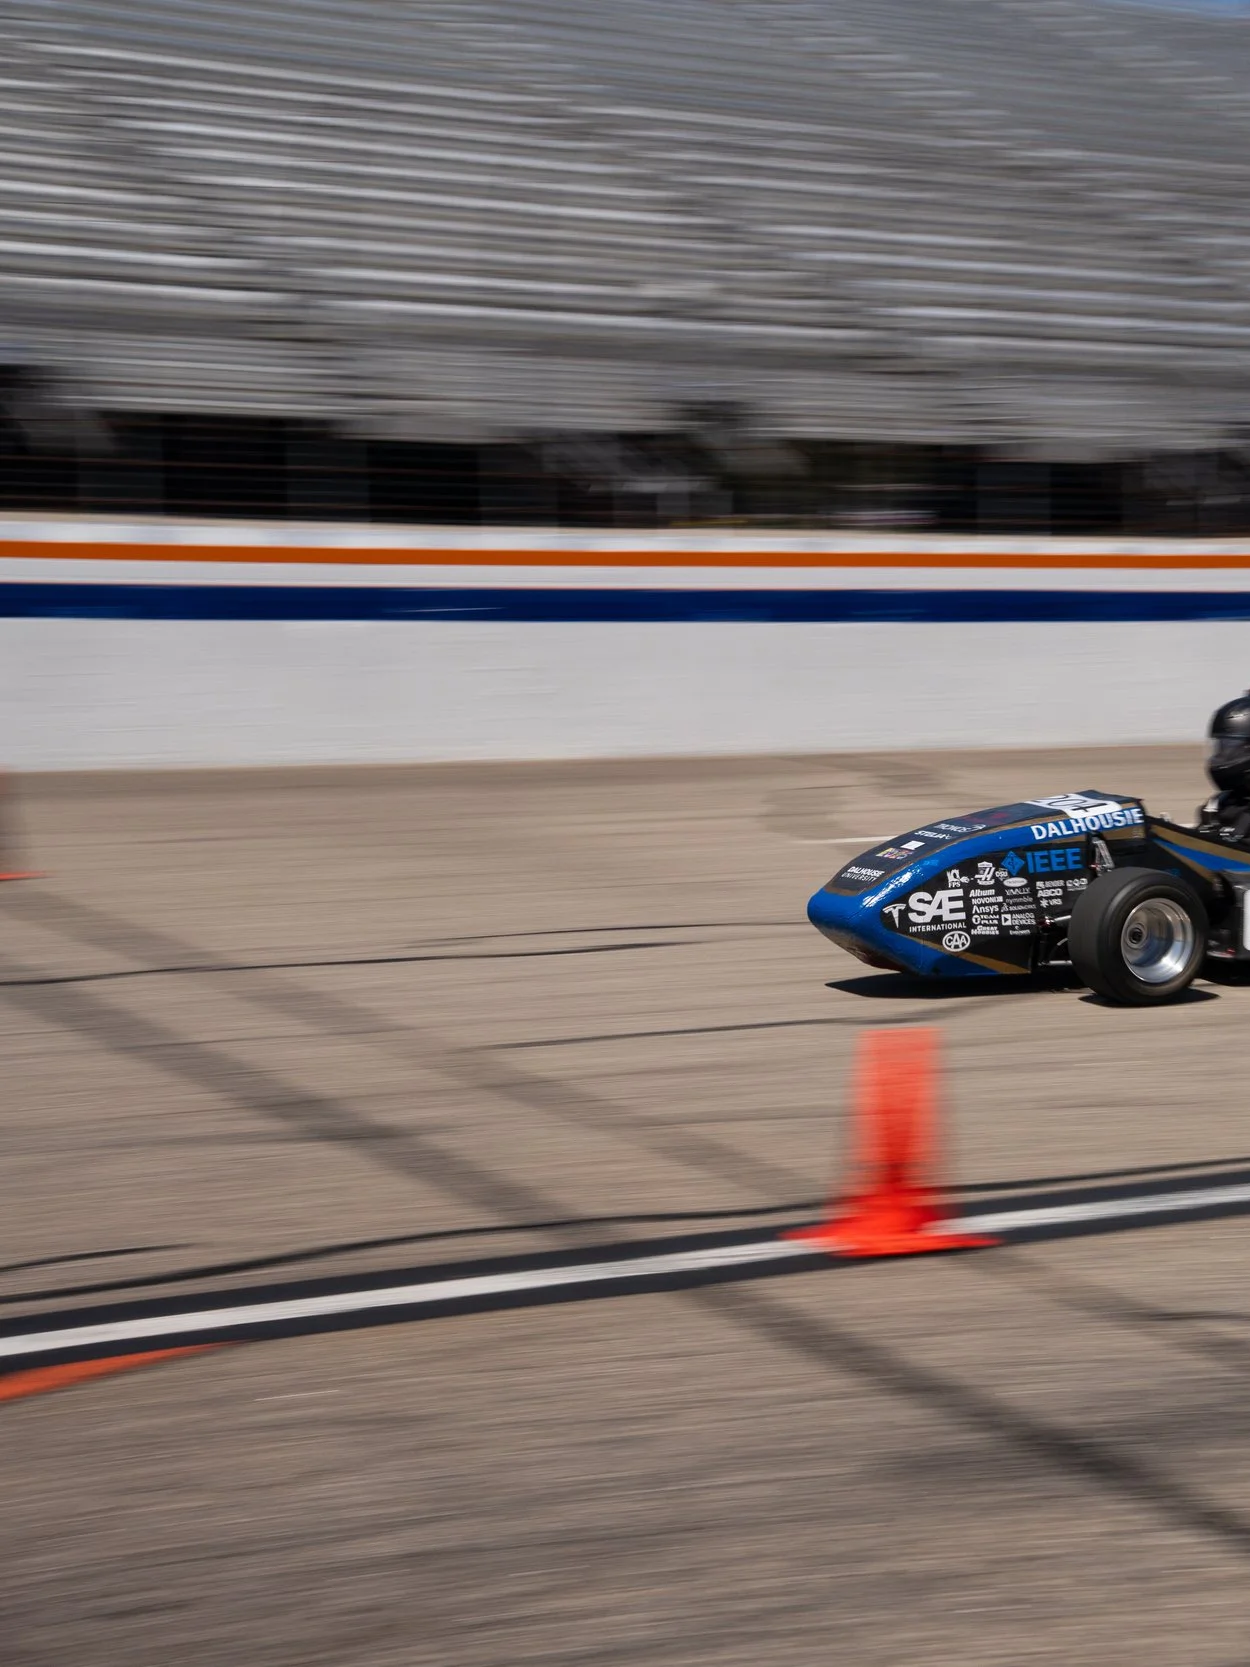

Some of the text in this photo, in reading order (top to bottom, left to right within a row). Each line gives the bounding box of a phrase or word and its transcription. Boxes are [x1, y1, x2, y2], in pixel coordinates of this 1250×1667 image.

[1031, 808, 1145, 840] DALHOUSIE
[1026, 848, 1083, 874] IEEE
[969, 889, 995, 898] Altium
[907, 888, 967, 924] SAE
[972, 905, 999, 914] Ansys
[909, 922, 967, 933] INTERNATIONAL
[946, 933, 967, 949] CAA
